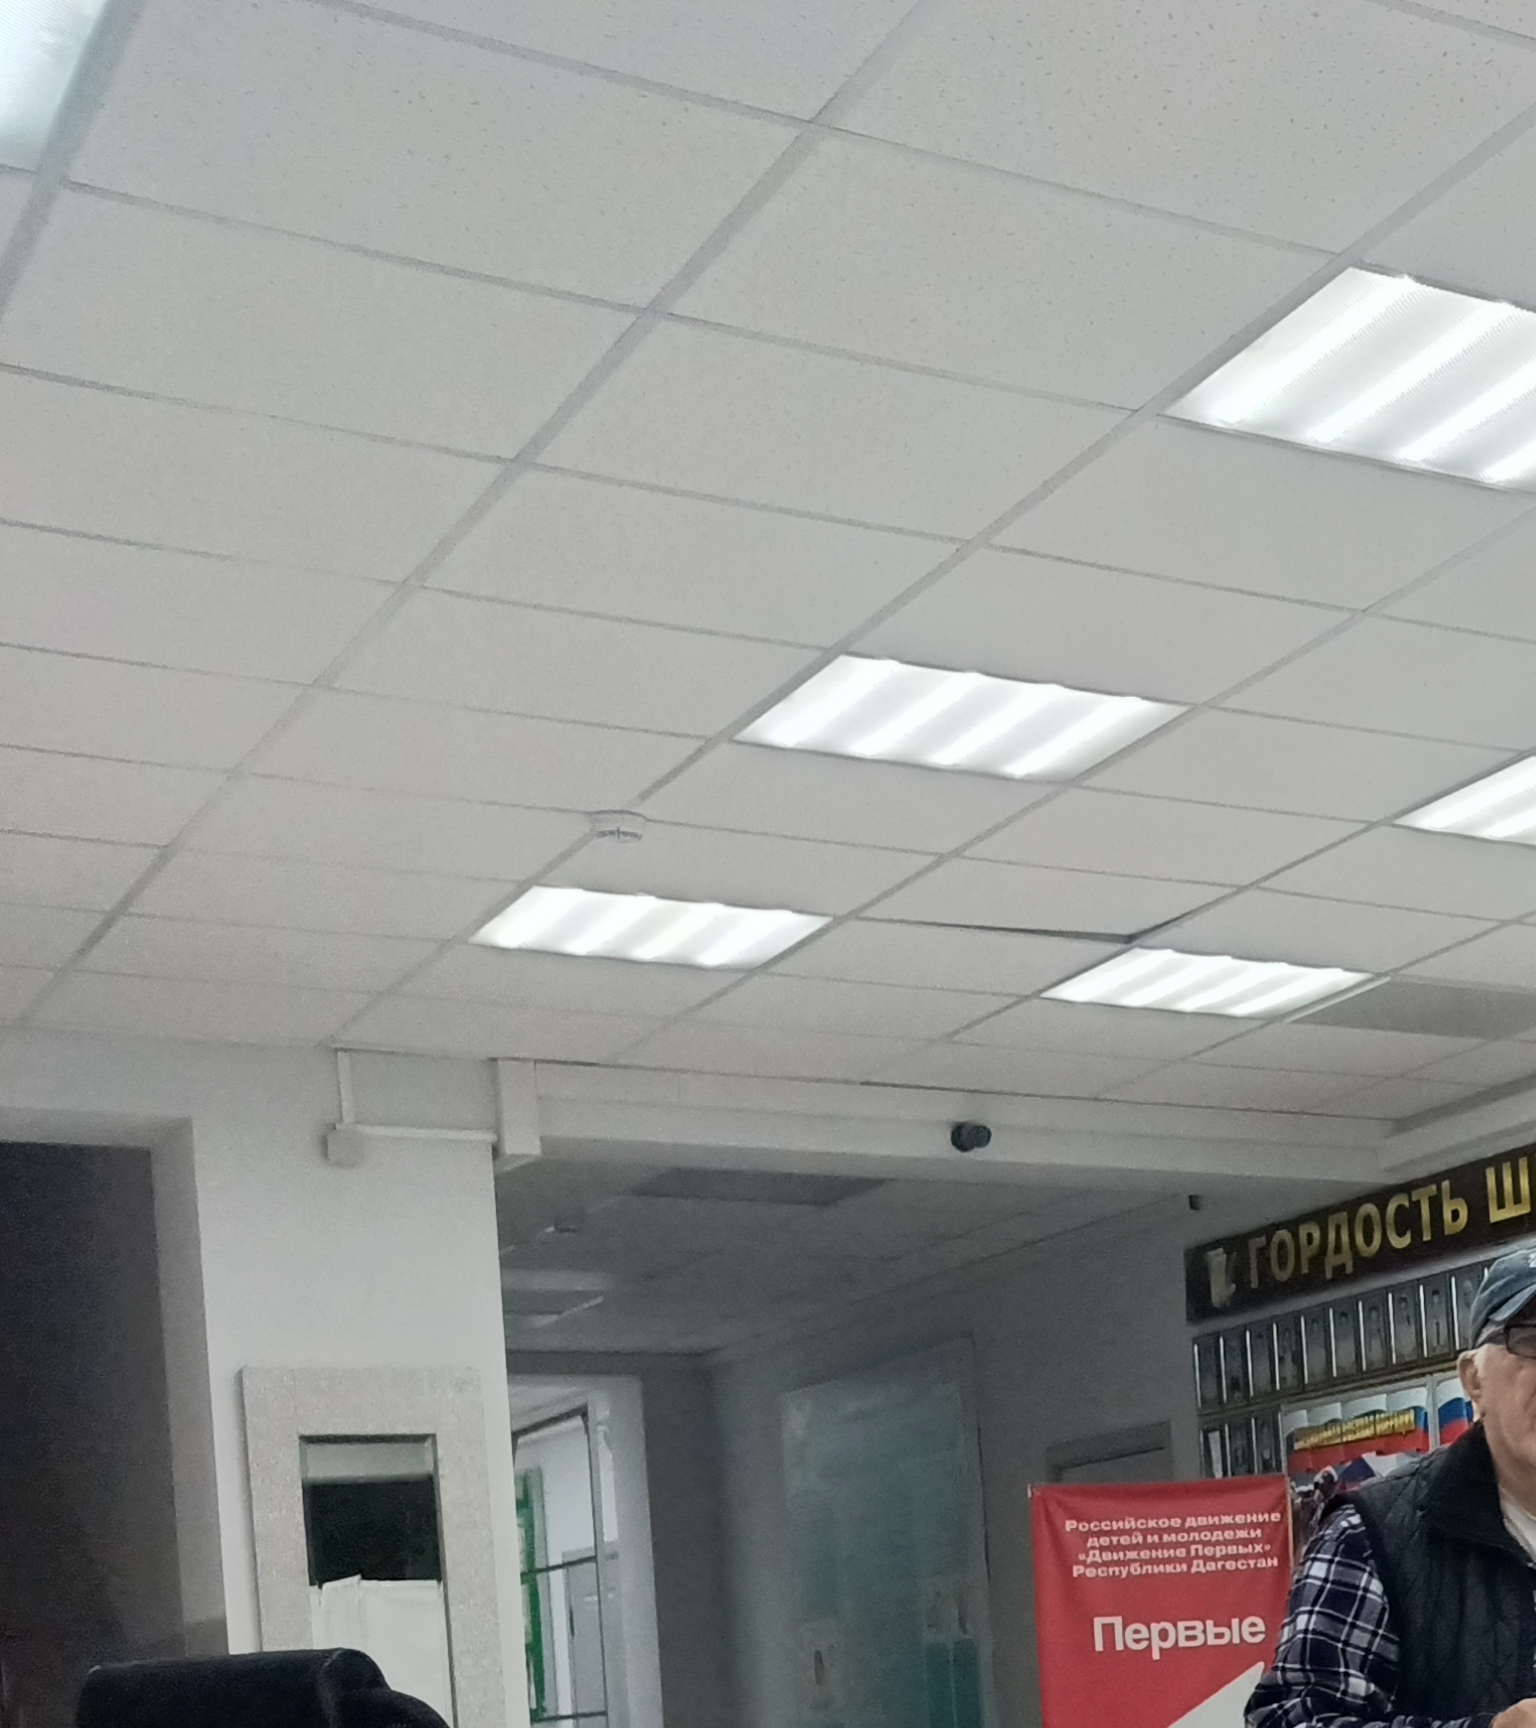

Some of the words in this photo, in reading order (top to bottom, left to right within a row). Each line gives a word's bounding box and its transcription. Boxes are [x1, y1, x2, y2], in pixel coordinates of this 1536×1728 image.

[1248, 1180, 1469, 1289] ГОРДОСТЬ
[1064, 1516, 1182, 1532] Российское
[1185, 1511, 1281, 1528] движение
[1087, 1531, 1143, 1549] детей
[1147, 1533, 1159, 1544] и
[1162, 1527, 1262, 1543] молодежи
[1078, 1547, 1187, 1564] «Движение
[1190, 1542, 1271, 1558] Первых»
[1072, 1561, 1187, 1579] Республики
[1190, 1556, 1279, 1574] Дагестан
[1093, 1615, 1266, 1661] Первые
